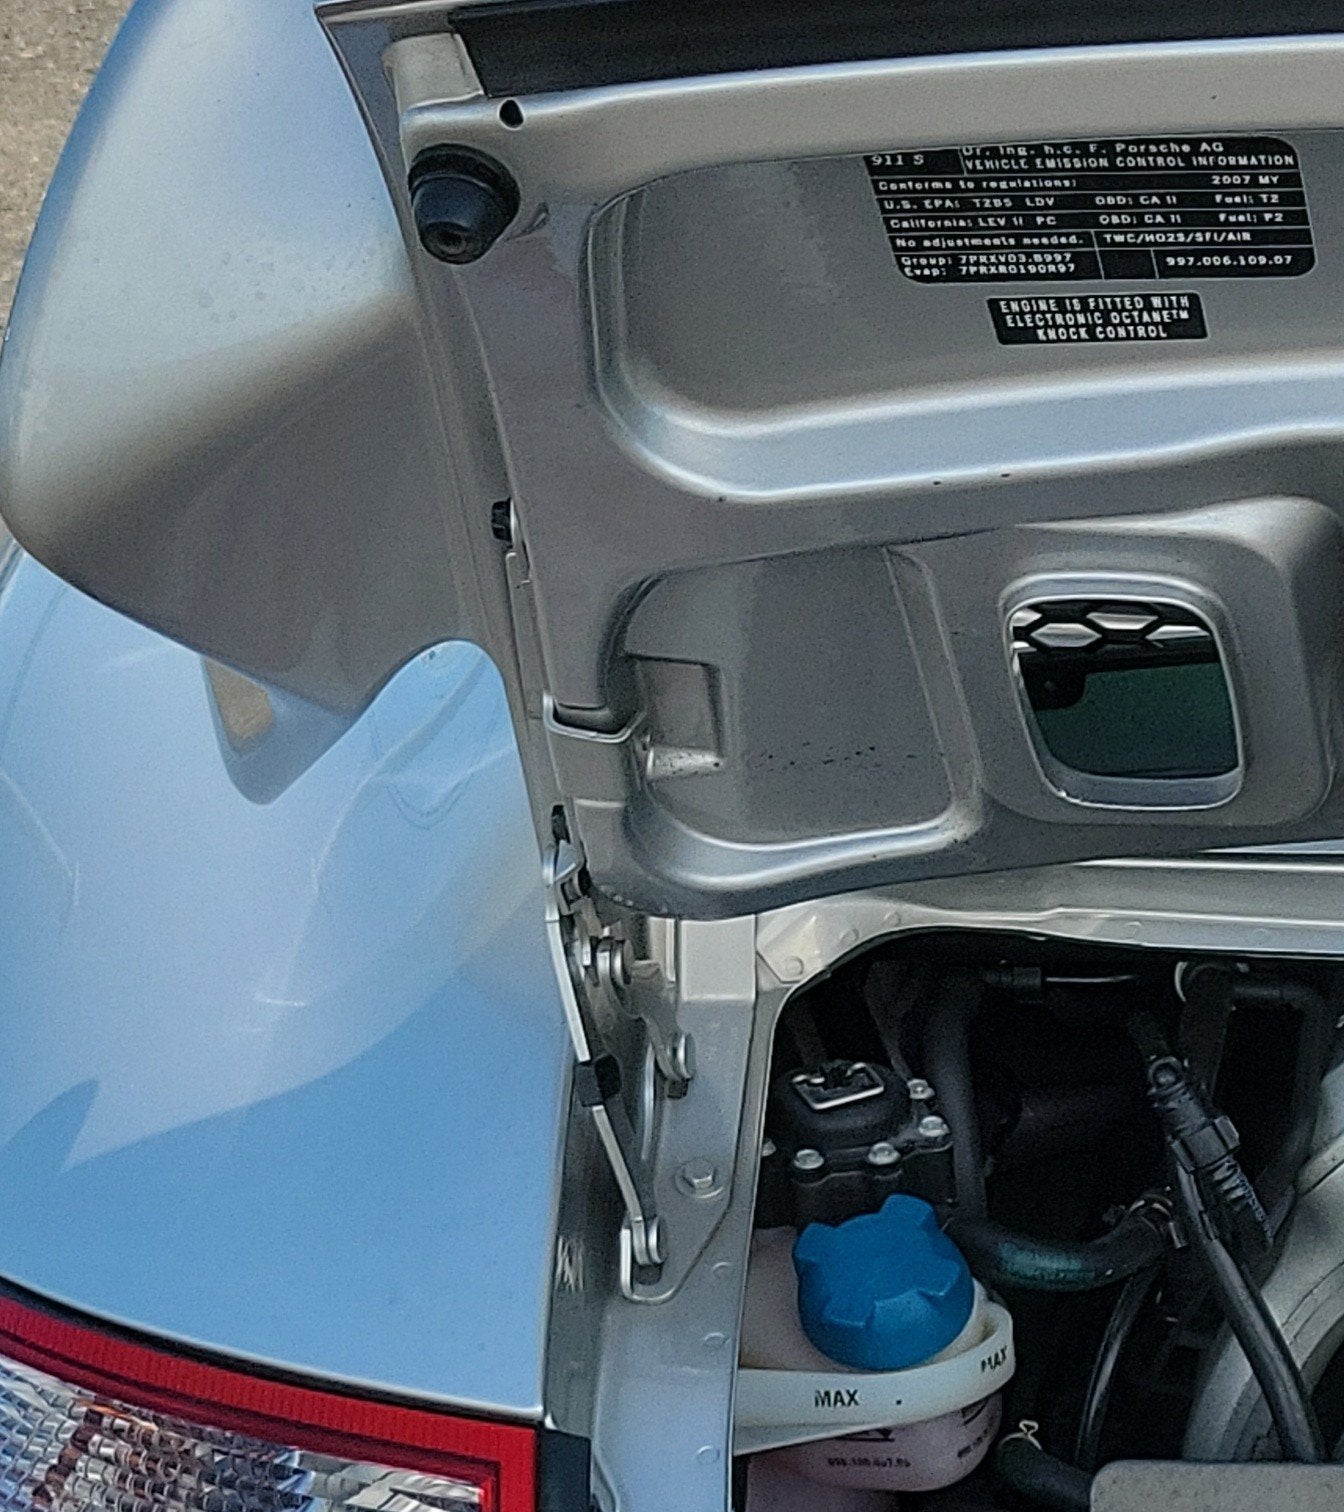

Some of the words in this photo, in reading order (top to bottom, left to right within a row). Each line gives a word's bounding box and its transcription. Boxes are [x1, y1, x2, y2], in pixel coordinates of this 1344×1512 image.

[998, 146, 1036, 157] Ing.
[1043, 144, 1081, 155] h.c.
[1089, 143, 1107, 154] F.
[1115, 142, 1191, 153] Porsche
[1199, 142, 1224, 153] AG
[871, 154, 904, 167] 911
[913, 153, 925, 166] S
[965, 157, 1029, 171] VEHICLE
[1034, 156, 1109, 170] EMISSION
[1116, 155, 1186, 168] CONTROL
[1192, 154, 1295, 168] INFORMATION
[878, 180, 953, 192] Conforms
[958, 179, 975, 190] to
[1211, 174, 1251, 186] 2007
[1258, 174, 1280, 185] MY
[883, 200, 918, 211] U.S.
[1025, 196, 1055, 208] LDV
[1138, 194, 1162, 206] CA
[977, 216, 1006, 228] LEV
[1035, 215, 1057, 227] PC
[1143, 213, 1166, 224] CA
[1262, 212, 1284, 222] P2
[894, 237, 917, 248] No
[921, 235, 1016, 249] adjustments
[1022, 234, 1084, 246] needed.
[900, 256, 953, 267] Group:
[999, 298, 1059, 313] ENGINE
[1065, 299, 1081, 311] IS
[1088, 296, 1144, 310] FITTED
[1150, 295, 1190, 309] WITH
[1005, 312, 1104, 327] ELECTRONIC
[1036, 326, 1089, 341] KNOCK
[1095, 325, 1167, 339] CONTROL
[980, 1345, 1008, 1374] MAX
[814, 1389, 860, 1408] MAX
